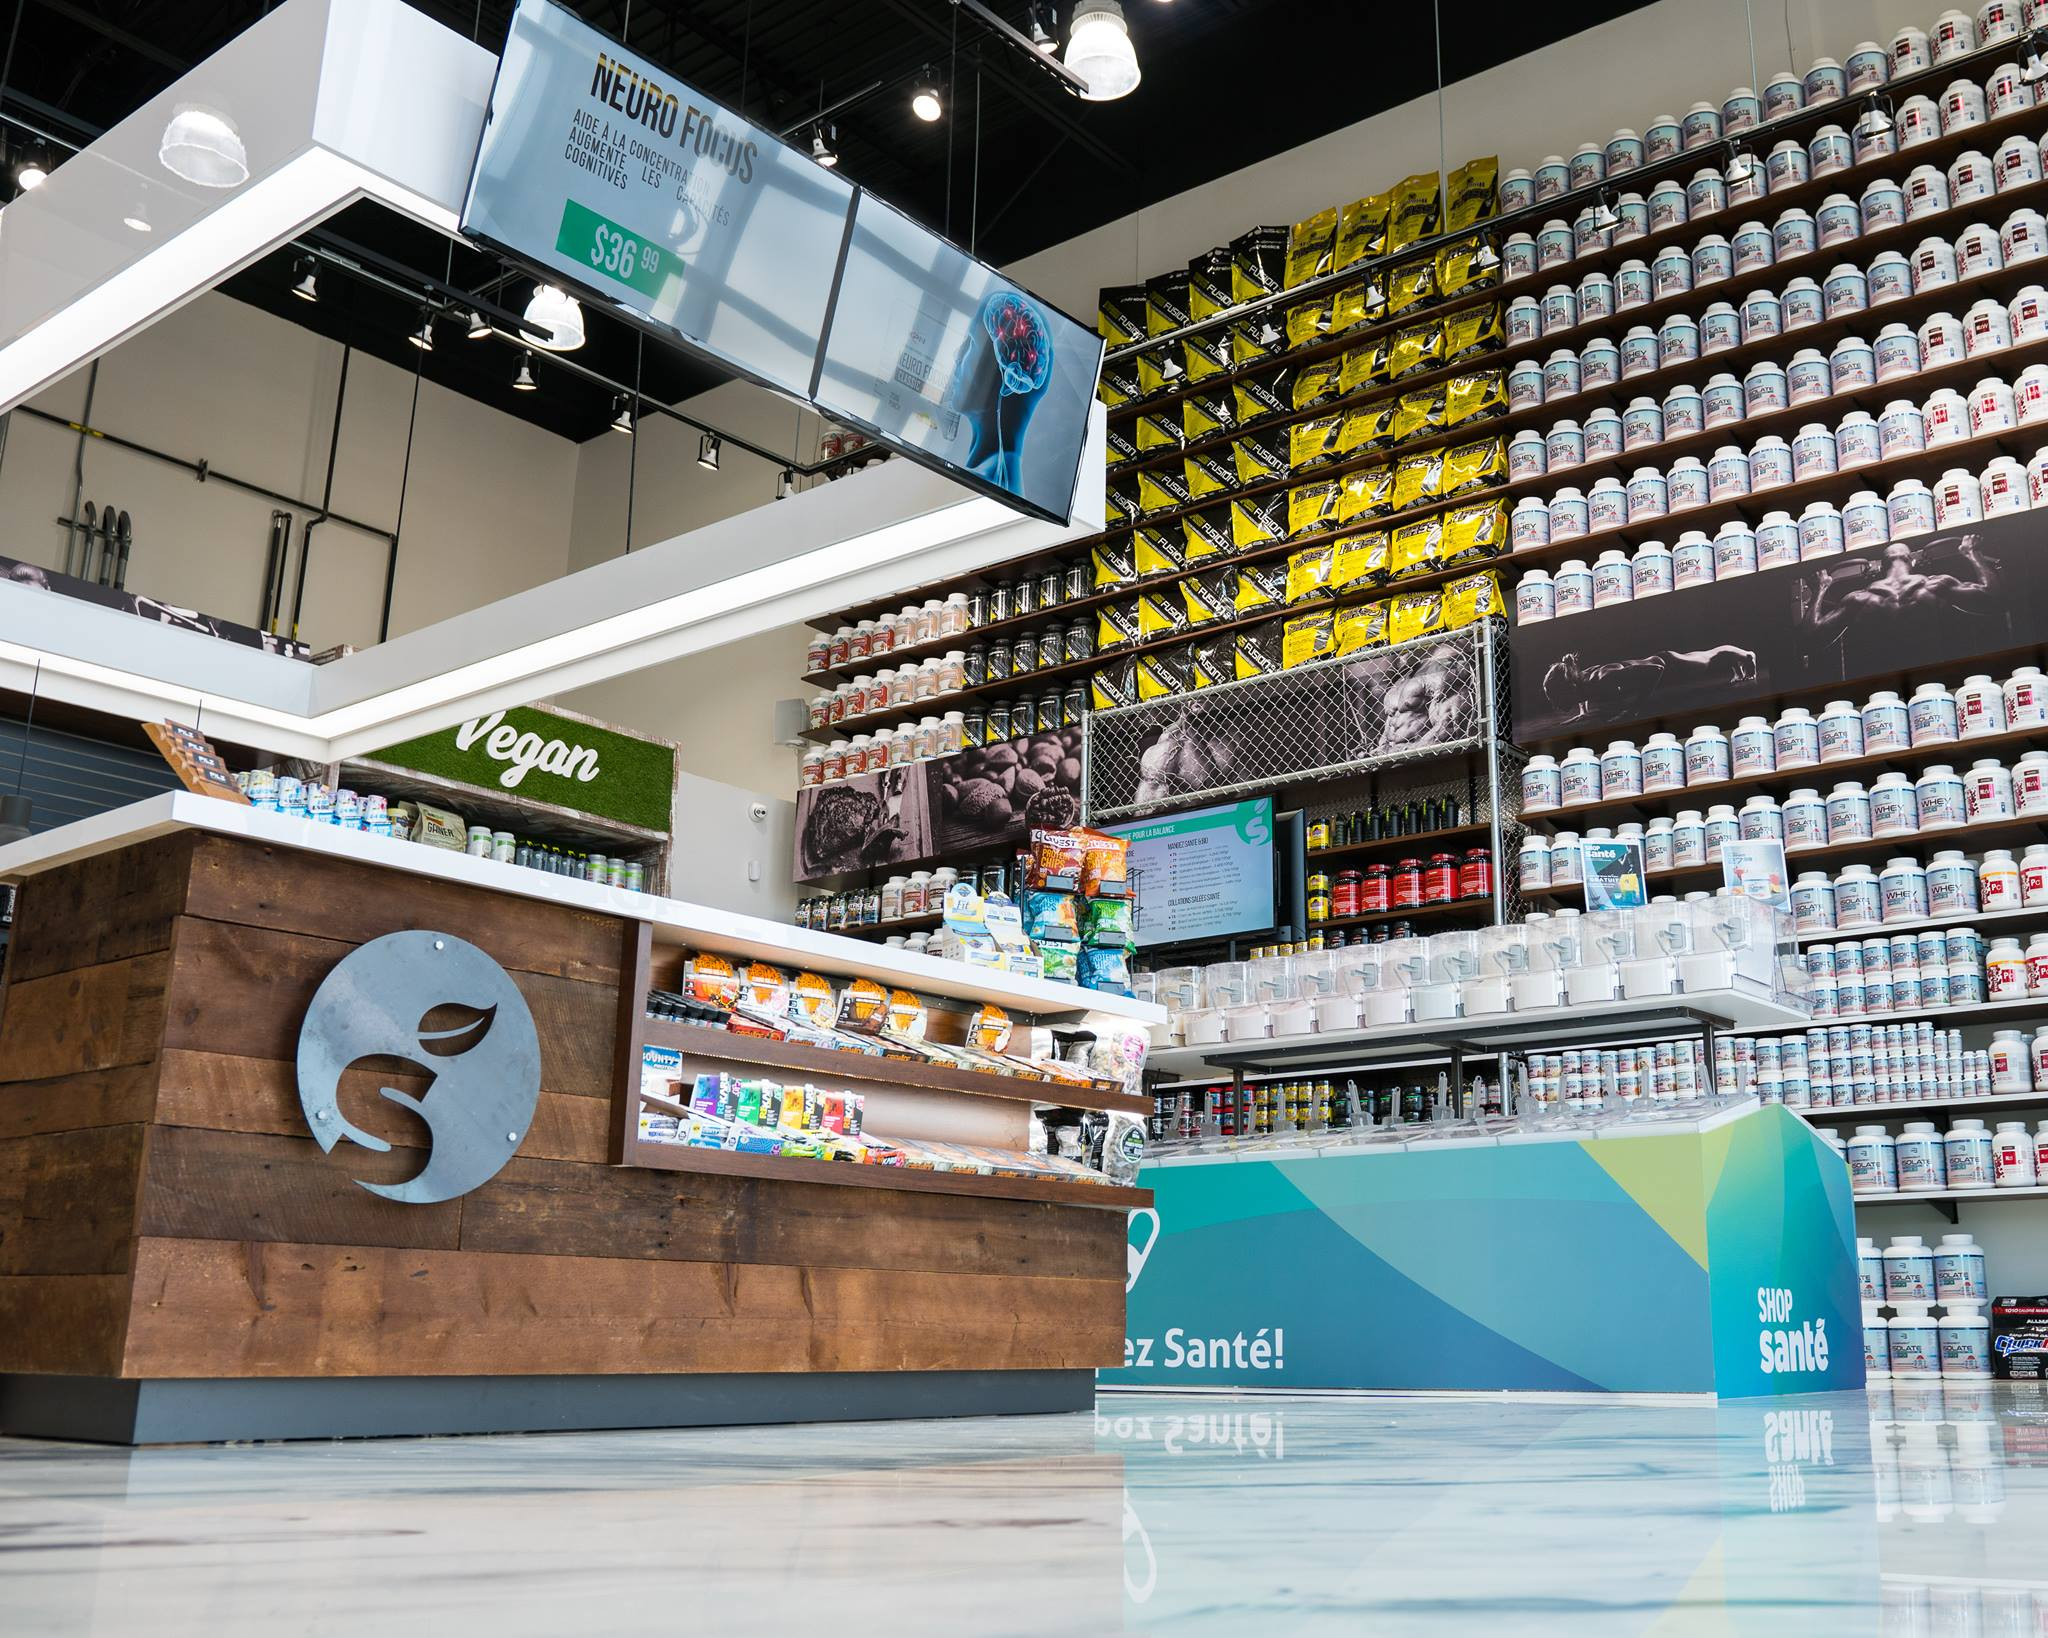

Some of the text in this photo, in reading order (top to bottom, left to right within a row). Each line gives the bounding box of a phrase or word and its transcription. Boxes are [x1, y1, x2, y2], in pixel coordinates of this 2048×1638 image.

[590, 52, 758, 185] NEURO FOCUS
[573, 109, 600, 135] AIDE
[601, 121, 610, 140] À
[613, 129, 627, 151] LA
[569, 126, 627, 170] AUGMENTE
[642, 166, 660, 189] LES
[564, 144, 628, 190] COGNITIVES
[590, 223, 660, 279] $36 99
[1583, 361, 1608, 372] WHEY
[1251, 386, 1279, 410] FUSION
[1665, 409, 1691, 421] WHEY
[1625, 421, 1651, 433] WHEY
[1586, 432, 1611, 443] WHEY
[1109, 433, 1137, 457] FUSION
[1550, 443, 1575, 454] WHEY
[1253, 443, 1282, 468] FUSION
[1511, 453, 1536, 464] WHEY
[1207, 460, 1237, 485] FUSION
[1162, 475, 1190, 501] FUSION
[1630, 492, 1656, 503] WHEY
[1591, 503, 1616, 514] WHEY
[1551, 512, 1576, 523] WHEY
[1158, 536, 1186, 565] FUSION
[1675, 557, 1701, 569] WHEY
[1634, 568, 1660, 579] WHEY
[1596, 576, 1620, 587] WHEY
[1556, 586, 1581, 598] WHEY
[1518, 595, 1543, 606] WHEY
[1244, 643, 1271, 669] FUSION
[1199, 653, 1220, 682] FUSION
[1153, 662, 1181, 691] FUSION
[1865, 721, 1893, 731] ISOLATE
[1820, 730, 1848, 739] ISOLATE
[1777, 737, 1804, 746] ISOLATE
[455, 711, 600, 788] Vegan
[1735, 746, 1761, 755] ISOLATE
[1688, 754, 1715, 766] WHEY
[1644, 762, 1671, 773] WHEY
[1604, 769, 1630, 780] WHEY
[1524, 782, 1550, 793] WHEY
[1563, 776, 1588, 787] WHEY
[1874, 802, 1904, 814] WHEY
[1920, 796, 1951, 808] WHEY
[1830, 812, 1858, 822] ISOLATE
[427, 822, 455, 838] GAINER
[1788, 819, 1817, 829] ISOLATE
[1152, 825, 1176, 837] BALANCE
[1044, 833, 1077, 848] QUEST
[1043, 849, 1070, 862] PROTEIN
[1584, 848, 1617, 860] santé
[1041, 857, 1066, 869] CHIPS
[1886, 889, 1918, 901] WHEY
[1931, 883, 1963, 895] WHEY
[1840, 896, 1871, 906] ISOLATE
[1852, 1161, 1881, 1170] ISOLATE
[1902, 1159, 1932, 1167] ISOLATE
[1950, 1156, 1981, 1165] ISOLATE
[1889, 1274, 1921, 1282] ISOLATE
[1939, 1271, 1969, 1280] ISOLATE
[1757, 1286, 1793, 1324] SHOP
[1164, 1327, 1284, 1370] Santé!
[1759, 1318, 1829, 1374] santé
[1995, 1335, 2048, 1358] QUICK
